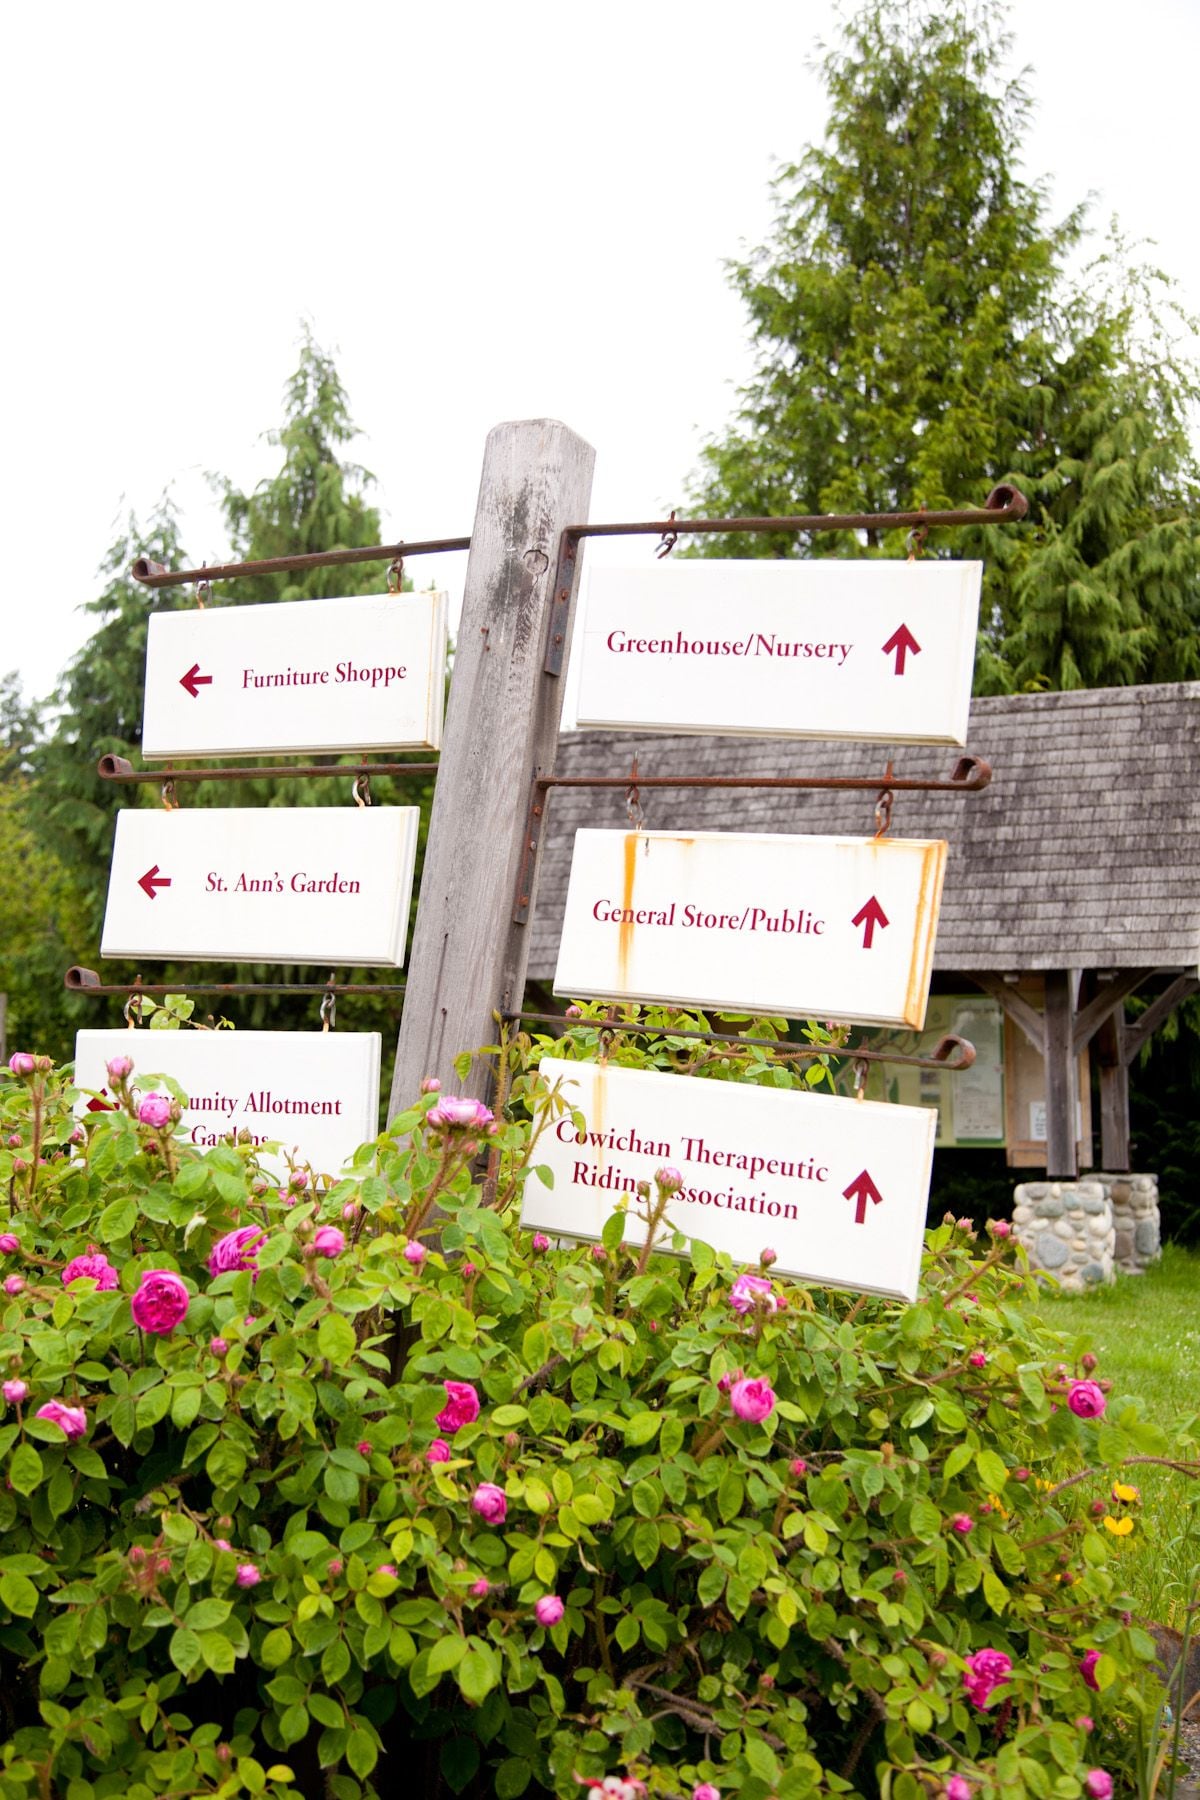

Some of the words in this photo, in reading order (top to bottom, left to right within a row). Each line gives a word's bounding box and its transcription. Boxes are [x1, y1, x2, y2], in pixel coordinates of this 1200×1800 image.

[607, 630, 854, 665] Greenhouse/Nursery
[242, 667, 329, 689] Furniture
[335, 661, 407, 688] Shoppe
[205, 872, 228, 893] St.
[234, 872, 284, 893] Ann's
[290, 872, 360, 894] Garden
[593, 900, 675, 927] General
[682, 904, 825, 935] Store/Public
[243, 1091, 342, 1116] Allotment
[191, 1124, 269, 1147] Gans
[556, 1119, 671, 1158] Cowichan
[681, 1136, 829, 1182] Therapeutic
[657, 1177, 799, 1220] ssociation
